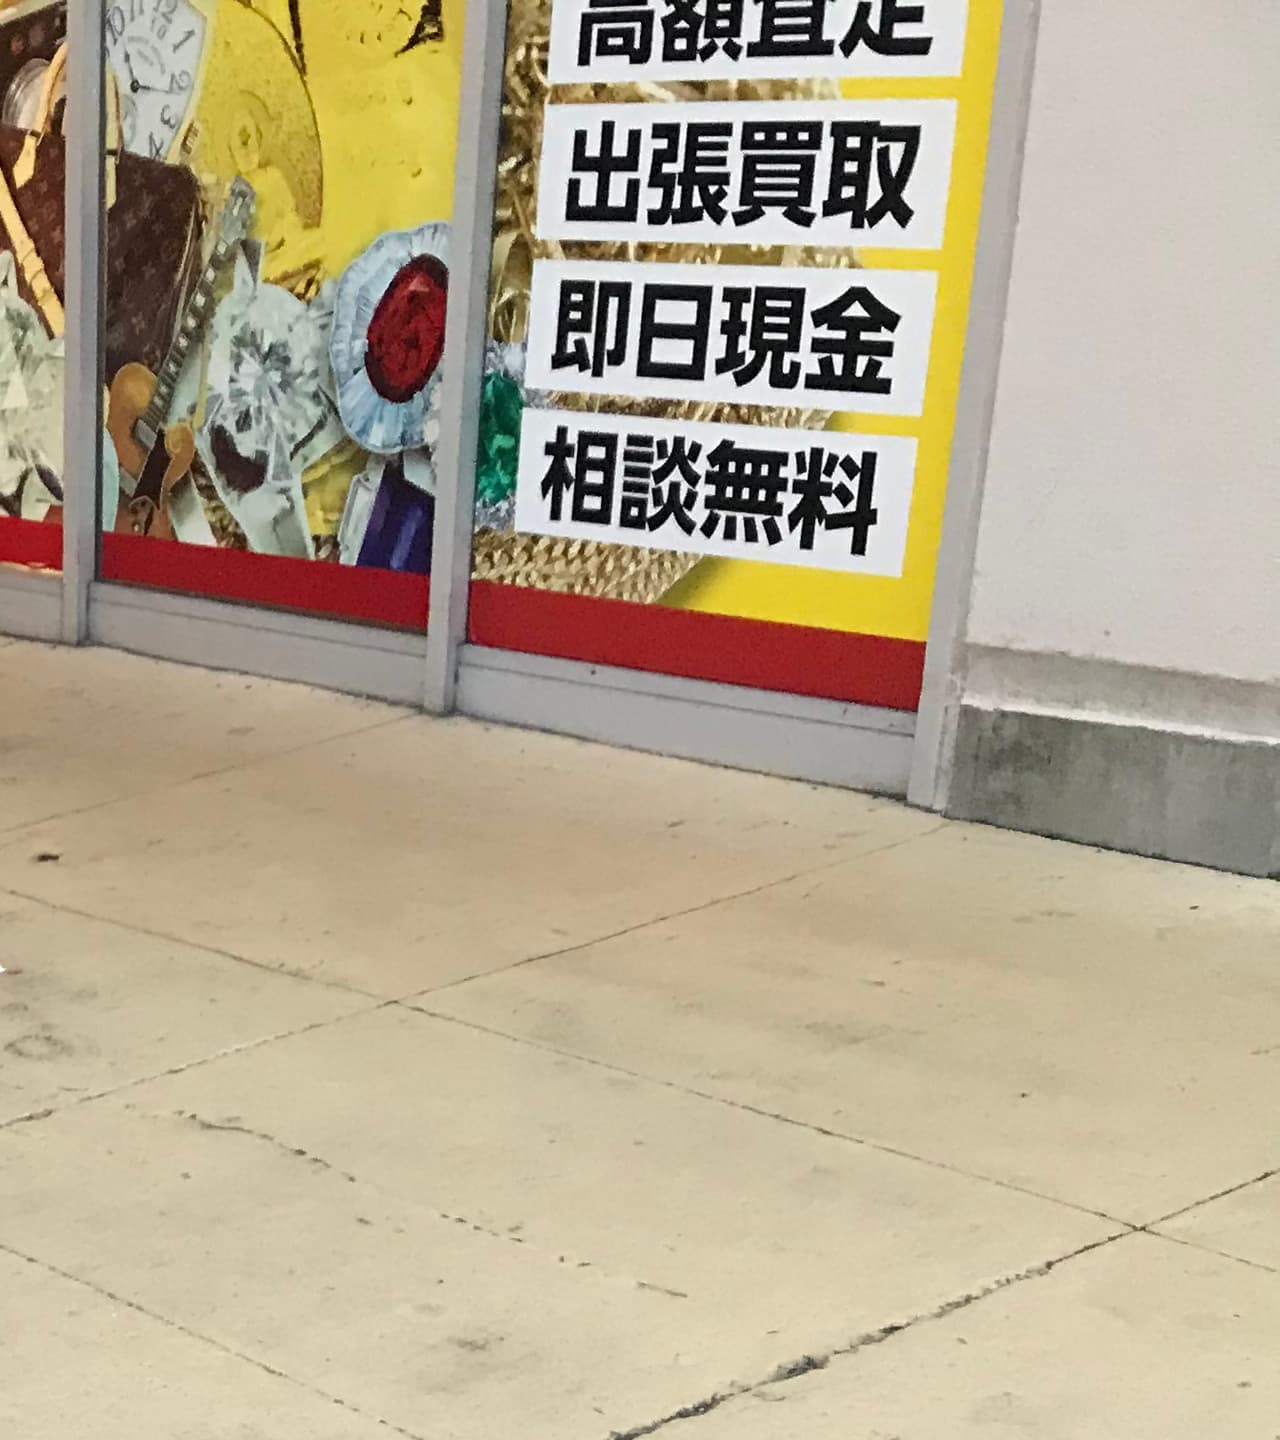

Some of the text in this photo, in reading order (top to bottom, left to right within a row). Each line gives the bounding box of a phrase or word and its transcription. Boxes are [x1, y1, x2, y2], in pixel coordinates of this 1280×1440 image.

[563, 120, 921, 230] 出張買取
[550, 279, 902, 395] 即日現金
[540, 426, 878, 556] 相談無料
